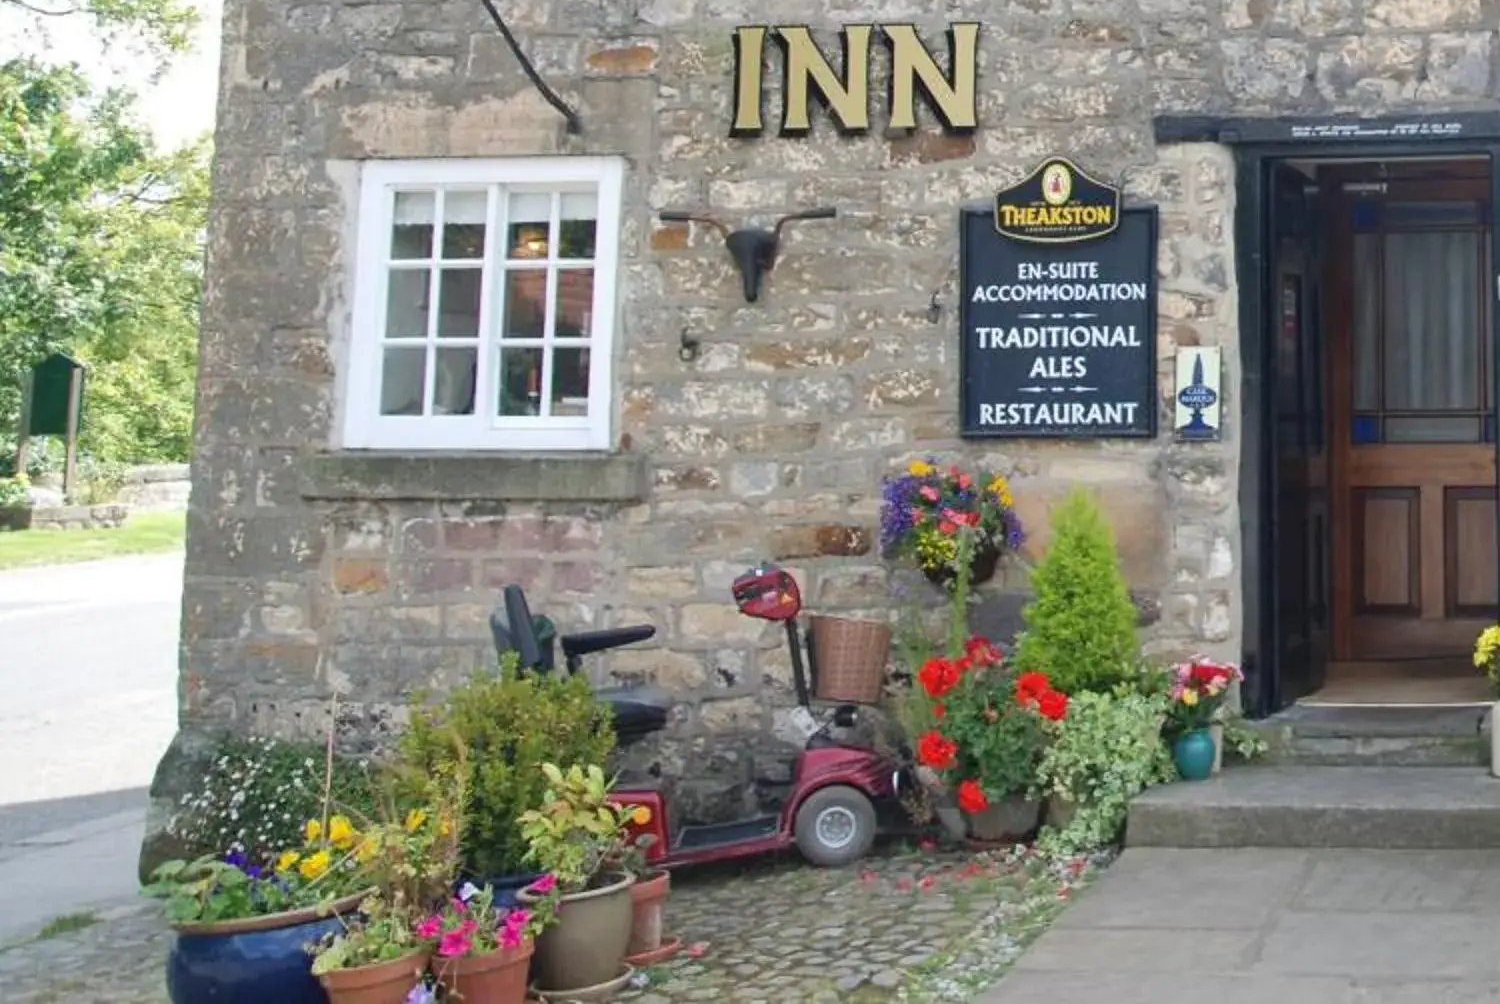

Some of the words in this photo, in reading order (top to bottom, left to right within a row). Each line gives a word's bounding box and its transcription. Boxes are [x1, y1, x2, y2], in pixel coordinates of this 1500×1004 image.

[729, 21, 982, 137] INN
[1000, 204, 1111, 226] THEAKSTON
[1018, 262, 1099, 280] EN-SUITE
[972, 283, 1147, 303] ACCOMMODATION
[975, 326, 1141, 348] TRADITIONAL
[1029, 356, 1086, 378] ALES
[979, 403, 1138, 424] RESTAURANT
